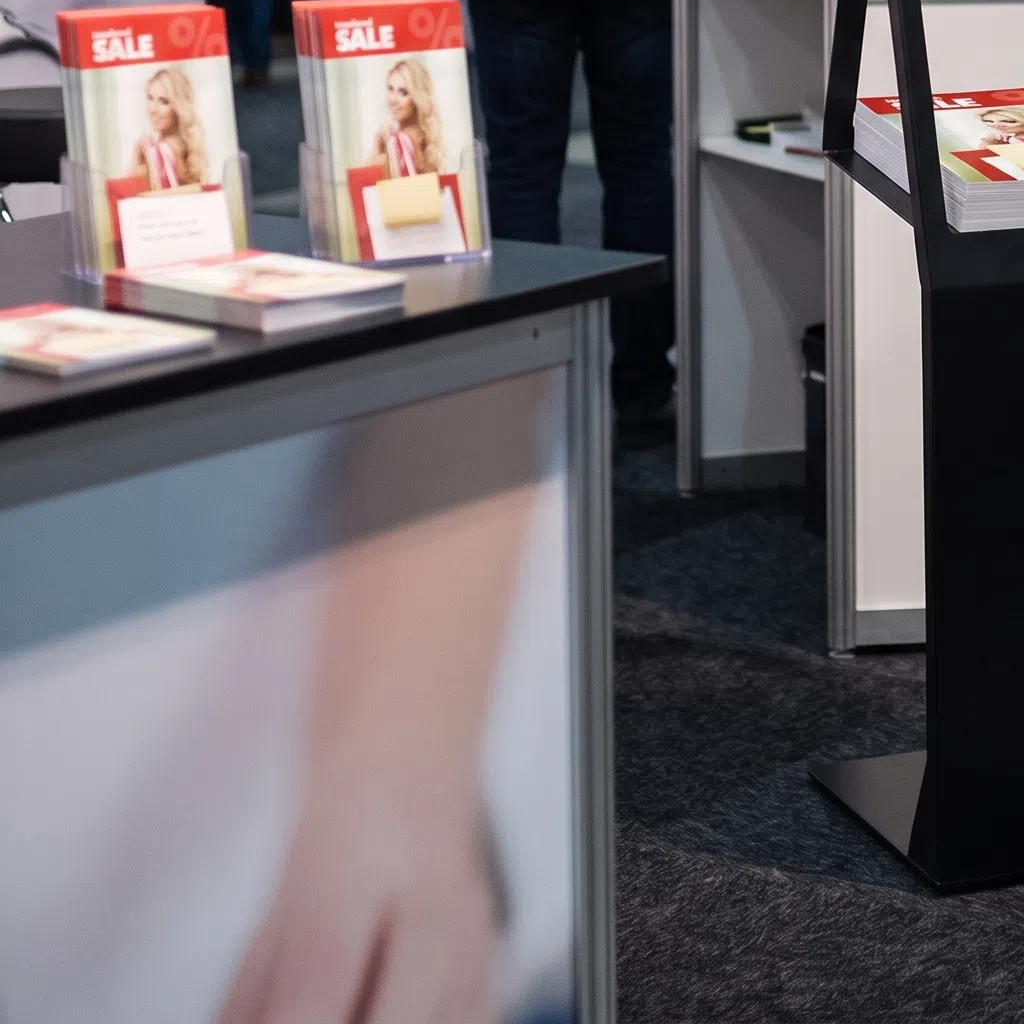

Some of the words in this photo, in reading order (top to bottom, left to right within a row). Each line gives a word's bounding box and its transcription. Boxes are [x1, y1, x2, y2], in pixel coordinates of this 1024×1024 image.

[92, 33, 156, 63] SALE
[335, 24, 396, 53] SALE
[891, 97, 983, 111] LE
